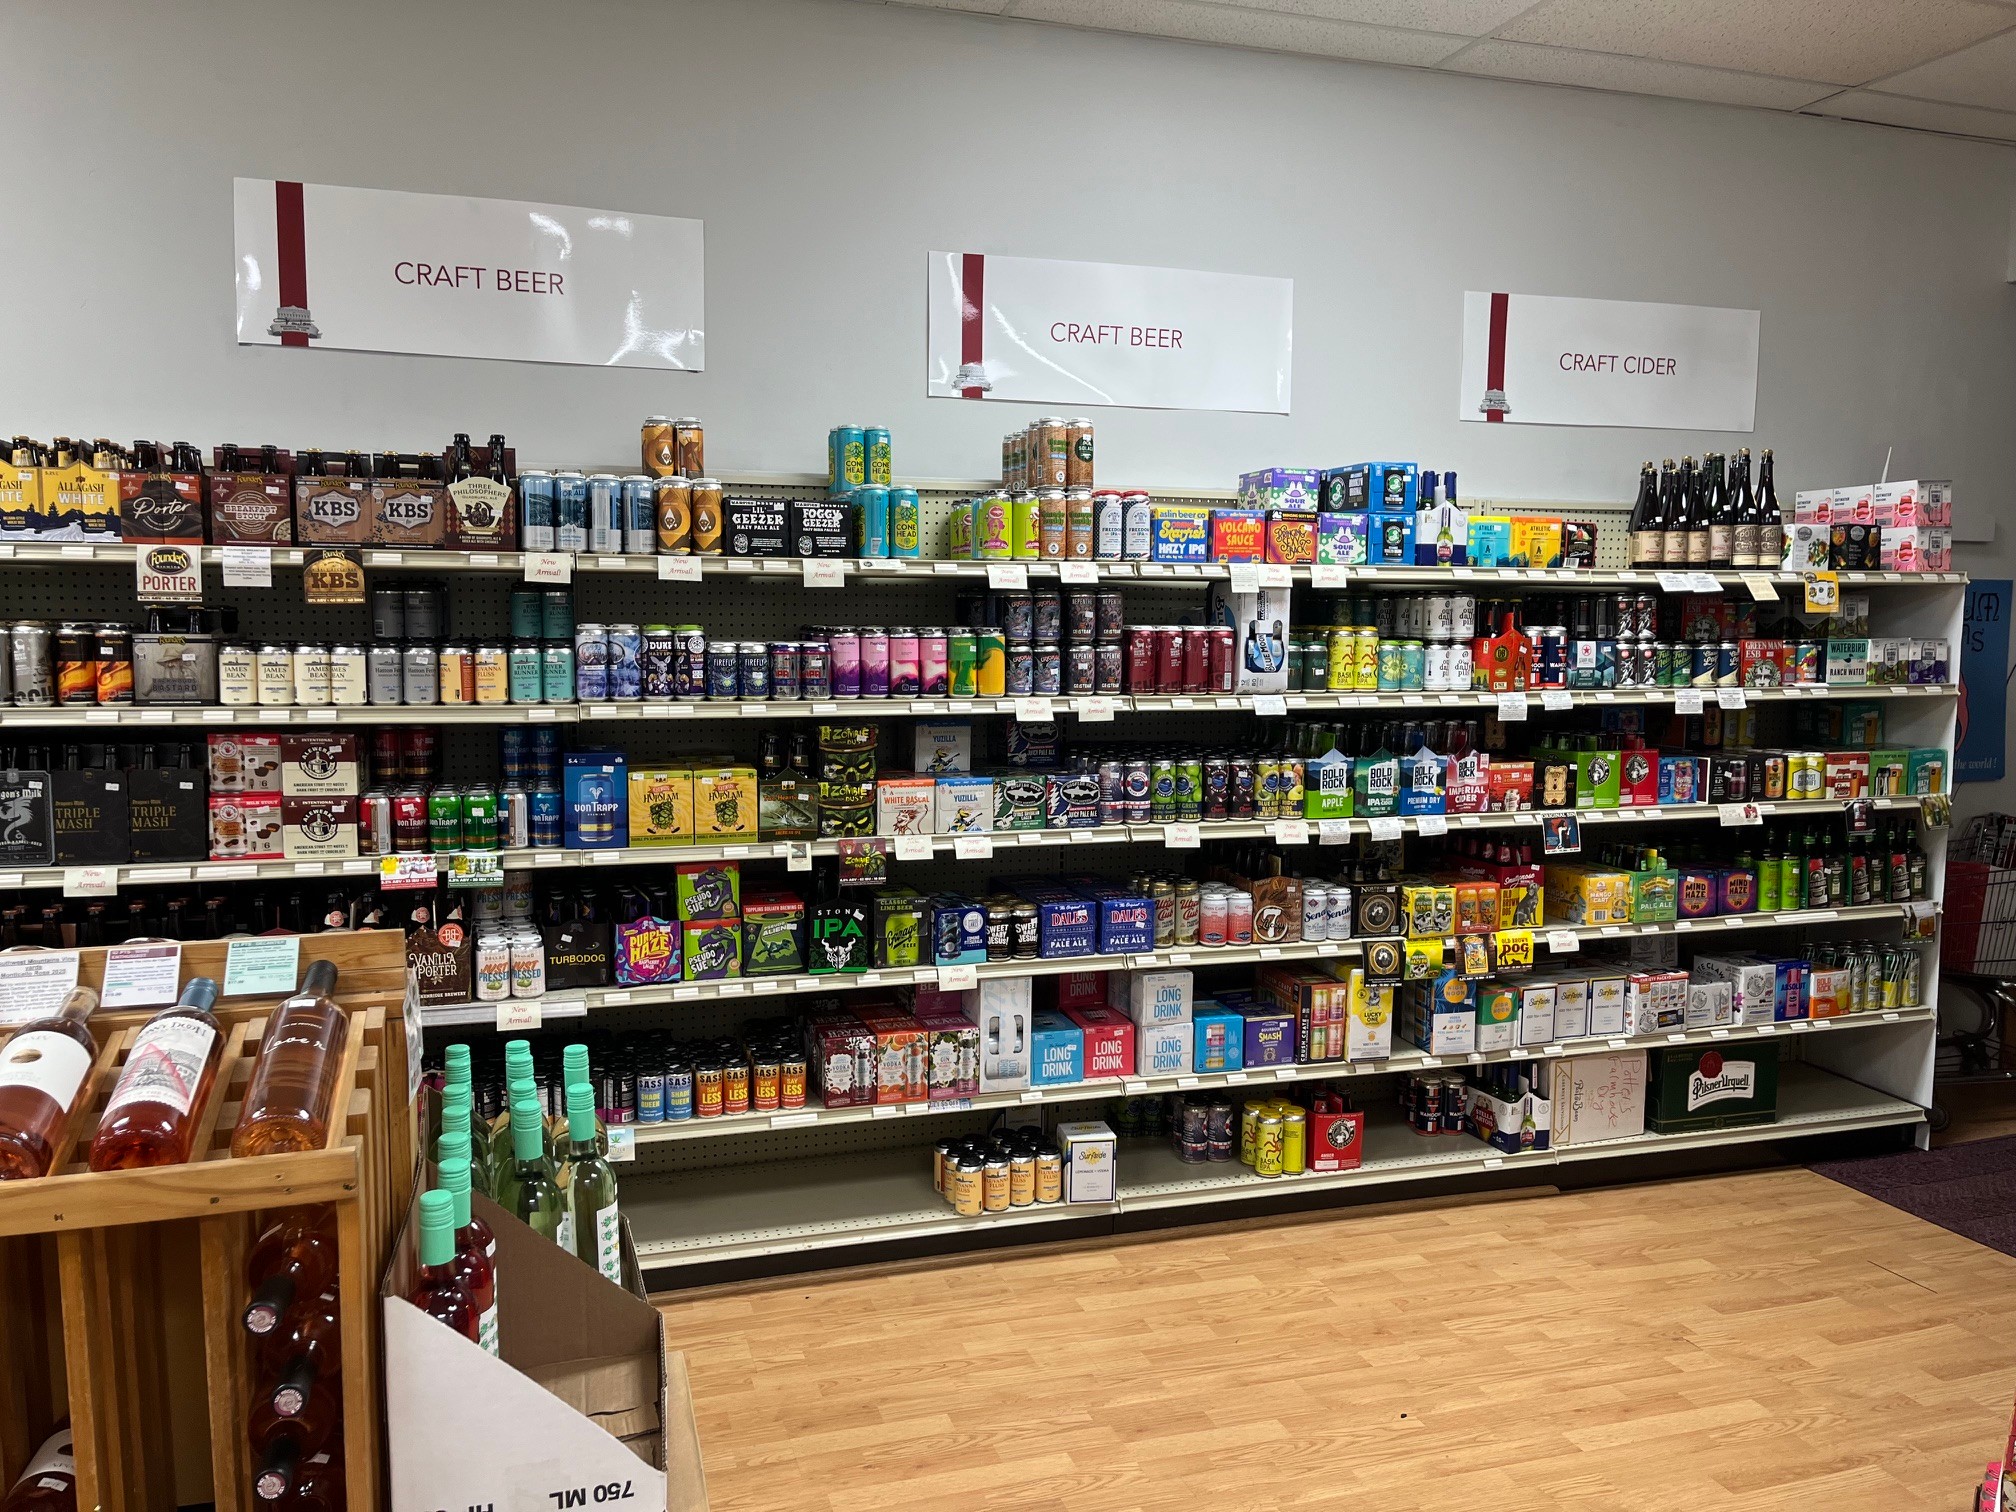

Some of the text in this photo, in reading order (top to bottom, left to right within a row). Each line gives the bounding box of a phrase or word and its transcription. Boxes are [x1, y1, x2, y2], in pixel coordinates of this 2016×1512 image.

[394, 262, 564, 295] CRAFT BEER
[1050, 322, 1183, 349] CRAFT BEER
[1559, 352, 1676, 375] CRAFT CIDER
[845, 460, 863, 468] CONE
[58, 480, 104, 492] ALLAGASH
[58, 492, 104, 505] WHITE
[133, 497, 190, 517] Porter
[224, 505, 277, 514] BREAKFAST
[313, 500, 355, 516] KBS
[388, 502, 428, 518] KBS
[732, 514, 784, 525] GEEZER
[1160, 510, 1176, 519] aslin
[1177, 511, 1192, 519] beer
[803, 519, 840, 527] GEEZER
[896, 524, 916, 532] CONE
[1219, 522, 1261, 533] VOLCANO
[896, 530, 916, 538] HEAD
[1226, 534, 1254, 546] SAUCE
[1158, 543, 1205, 555] HAZY IPA
[143, 577, 196, 591] PORTER
[311, 572, 359, 589] KBS
[650, 641, 672, 650] DUKE
[1765, 642, 1782, 650] MAN
[1831, 643, 1866, 653] WATERBIRD
[1745, 650, 1761, 658] ESB
[1830, 668, 1864, 676] RANCH WATER
[1458, 760, 1475, 771] BOLD
[1954, 760, 1968, 770] the
[1322, 768, 1344, 779] BOLD
[1370, 767, 1392, 778] BOLD
[1458, 770, 1475, 778] ROCK
[1322, 778, 1344, 789] ROCK
[1370, 778, 1392, 788] ROCK
[1414, 776, 1434, 786] ROCK
[0, 789, 42, 800] gon's Milk
[1449, 786, 1486, 796] IMPERIAL
[884, 796, 930, 804] WHITE RASCAL
[1322, 798, 1343, 808] APPLE
[1455, 795, 1477, 803] CIDER
[55, 807, 100, 818] TRIPLE
[132, 806, 176, 817] TRIPLE
[55, 818, 93, 829] MASH
[132, 818, 169, 828] MASH
[1686, 884, 1706, 892] MIND
[1729, 879, 1748, 888] MIND
[1729, 886, 1748, 894] HAZE
[684, 891, 712, 906] PSEUDO
[687, 903, 704, 915] SUE
[812, 918, 863, 939] IPA
[986, 925, 1009, 935] SWEET
[630, 929, 669, 947] PURPLE
[1051, 938, 1087, 948] PALE ALE
[1110, 936, 1146, 945] PALE ALE
[630, 935, 670, 963] HAZE
[1502, 943, 1529, 953] DOG
[409, 952, 456, 966] VANILLA
[550, 954, 605, 964] TURBODOG
[688, 950, 716, 965] PSEUDO
[417, 965, 457, 979] PORTER
[480, 962, 509, 973] JUST
[691, 961, 709, 973] SUE
[1070, 982, 1098, 997] DRINK
[1781, 982, 1806, 991] ABSOLUT
[1817, 985, 1832, 993] ROCK
[1156, 989, 1181, 1003] LONG
[1154, 1004, 1182, 1018] DRINK
[1259, 1031, 1282, 1043] SMASH
[1095, 1040, 1122, 1055] LONG
[1156, 1040, 1181, 1054] LONG
[1044, 1048, 1071, 1062] LONG
[1093, 1055, 1123, 1071] DRINK
[1153, 1054, 1182, 1069] DRINK
[727, 1071, 748, 1079] SASS
[755, 1068, 777, 1076] SASS
[781, 1065, 803, 1074] SASS
[1042, 1062, 1073, 1077] DRINK
[668, 1077, 691, 1085] SASS
[700, 1074, 722, 1082] SASS
[1721, 1074, 1750, 1091] Urquell
[638, 1079, 662, 1089] SASS
[783, 1084, 802, 1095] LESS
[729, 1089, 748, 1100] LESS
[756, 1086, 776, 1097] LESS
[671, 1097, 690, 1105] QUEEN
[702, 1091, 722, 1104] LESS
[640, 1100, 660, 1108] QUEEN
[1475, 1108, 1493, 1121] STELLA
[1079, 1151, 1106, 1161] Surfside
[549, 1480, 636, 1509] 750 ML
